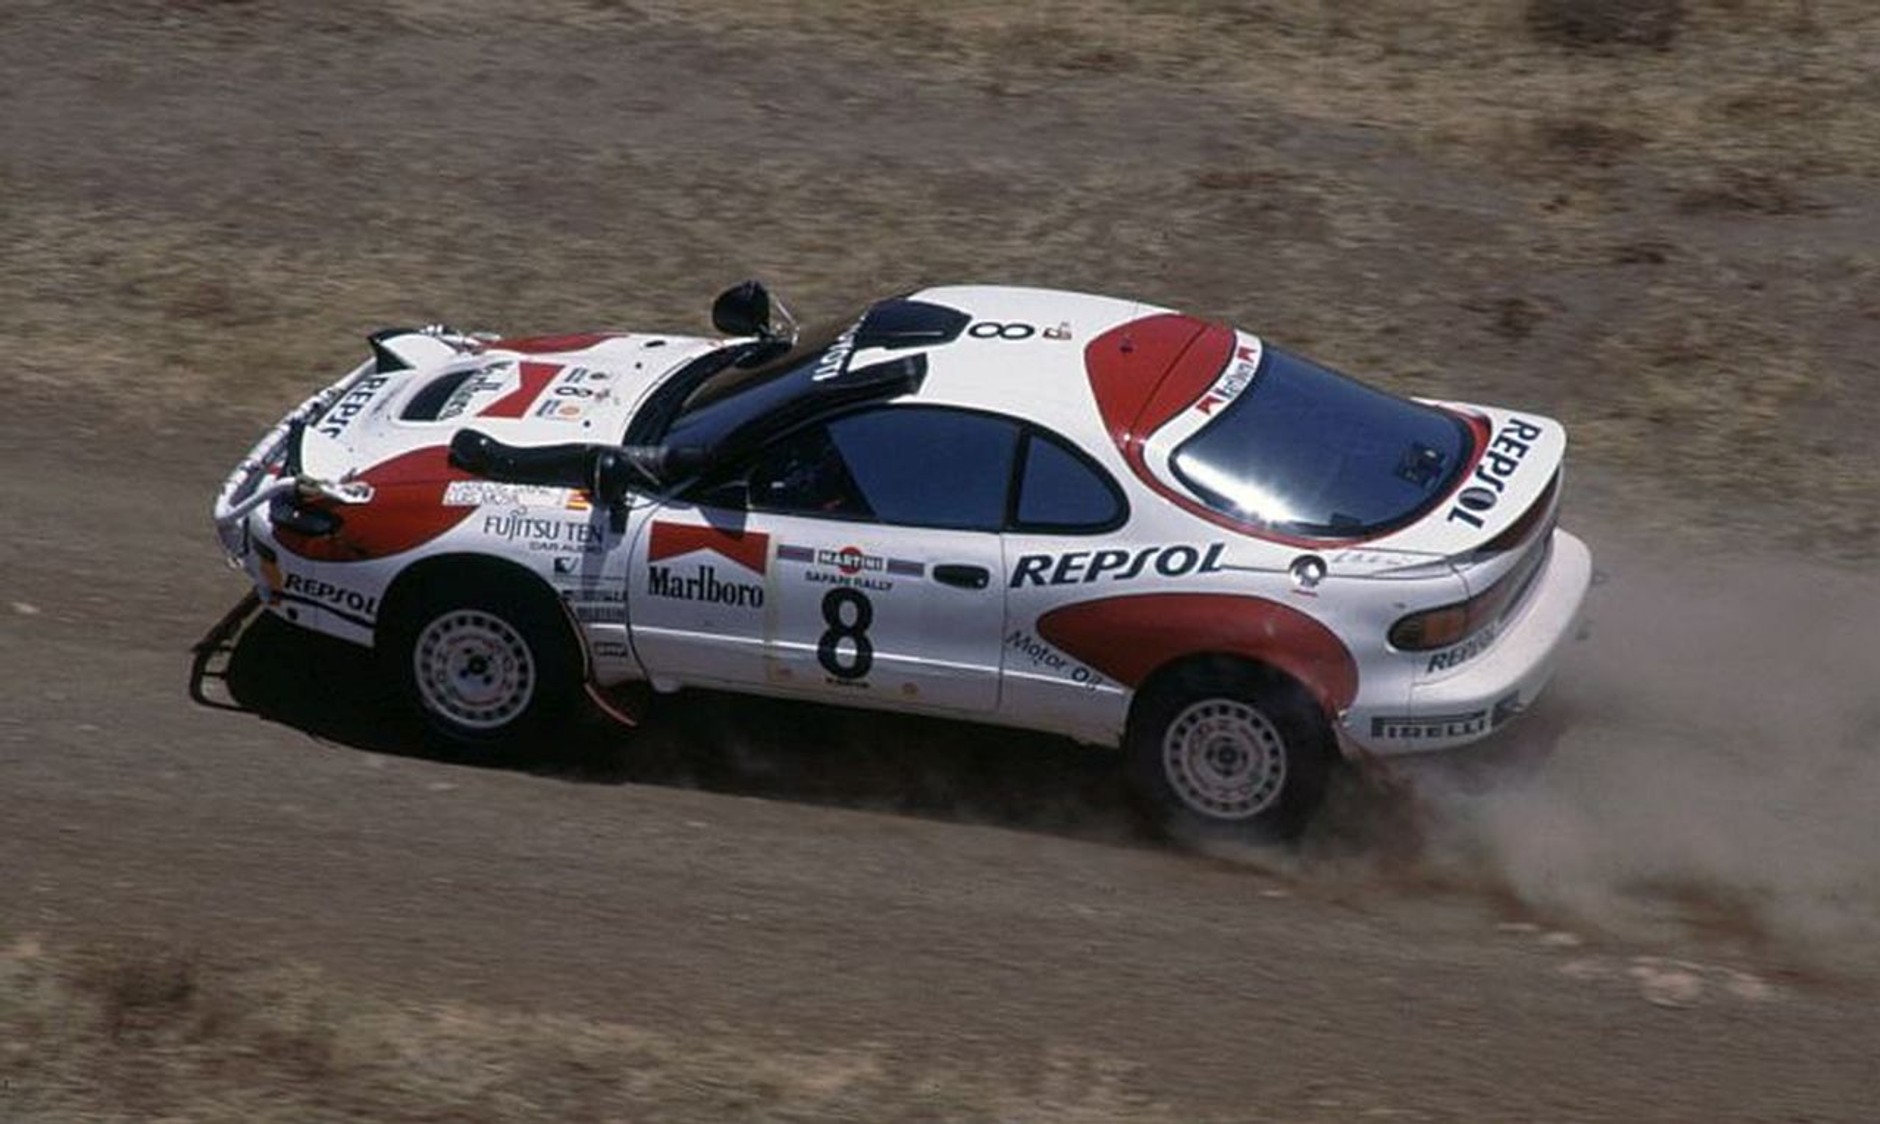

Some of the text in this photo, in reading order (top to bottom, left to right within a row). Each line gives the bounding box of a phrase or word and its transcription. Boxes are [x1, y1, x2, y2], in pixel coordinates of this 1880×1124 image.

[968, 321, 1035, 341] 8
[1447, 418, 1543, 529] REPSOL
[483, 511, 603, 543] FUJITSU TEN
[647, 565, 765, 609] Marlboro
[1008, 543, 1226, 588] REPSOL
[816, 586, 874, 680] 8
[1005, 629, 1067, 671] Motor
[1370, 708, 1488, 739] PIRELLI
